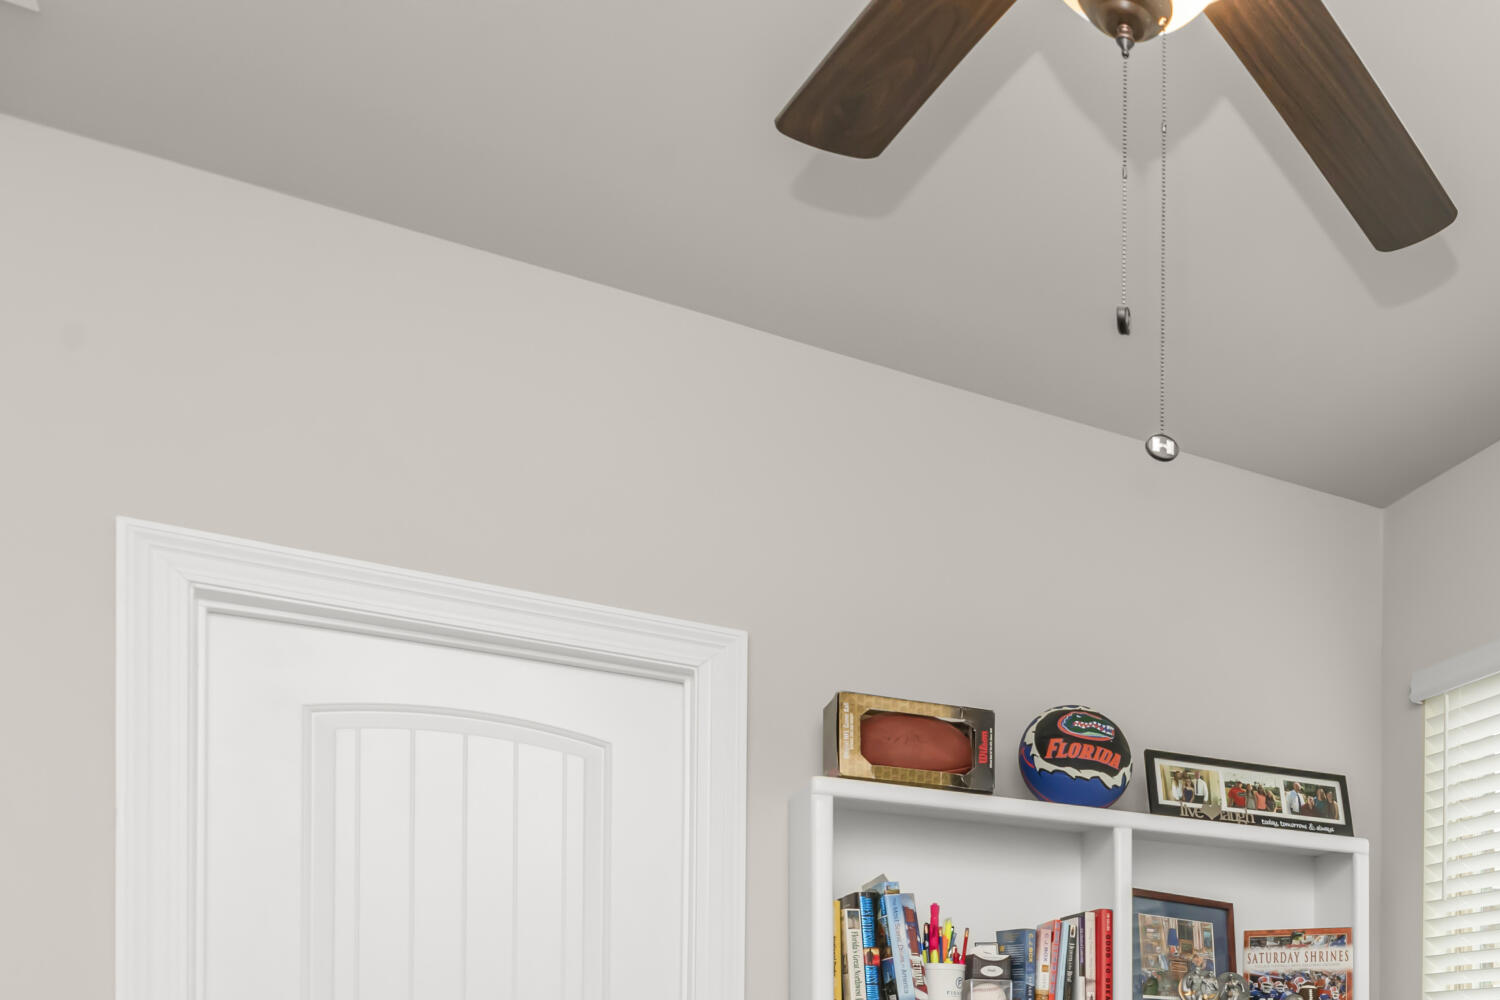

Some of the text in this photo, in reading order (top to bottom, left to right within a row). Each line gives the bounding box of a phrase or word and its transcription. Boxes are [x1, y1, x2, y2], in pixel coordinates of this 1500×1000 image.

[978, 730, 989, 764] Wilson
[1044, 738, 1122, 770] FLORIDA
[1179, 803, 1204, 819] live
[851, 931, 860, 953] Florida's
[1247, 949, 1349, 964] SATURDAY SHRINES
[1106, 964, 1110, 973] TO
